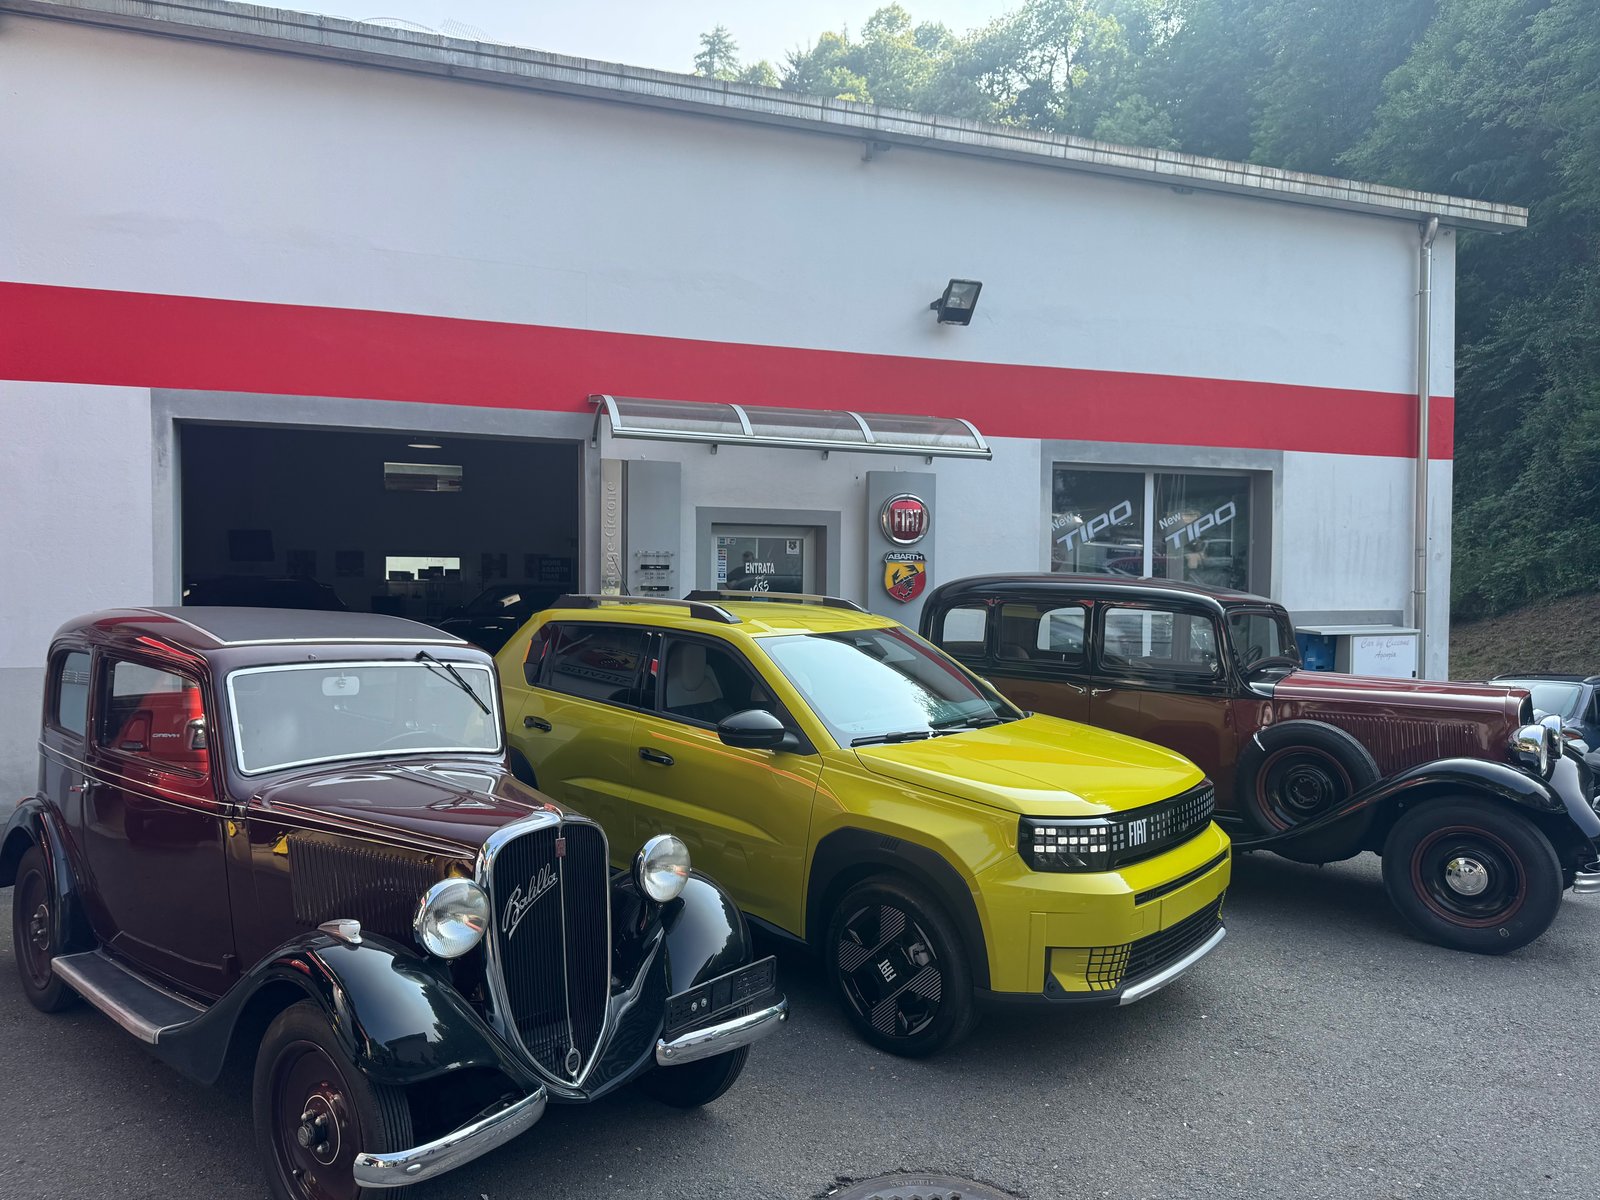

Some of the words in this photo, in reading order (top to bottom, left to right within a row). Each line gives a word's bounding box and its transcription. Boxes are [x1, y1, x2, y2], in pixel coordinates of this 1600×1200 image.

[604, 481, 616, 538] Ciccone
[894, 508, 922, 532] FIAT
[1051, 512, 1074, 531] New
[1158, 512, 1182, 530] New
[1056, 500, 1132, 552] TIPO
[1164, 501, 1237, 550] TIPO
[745, 562, 775, 574] ENTRATA
[888, 553, 923, 561] ABARTH
[1128, 818, 1148, 848] FIAT
[502, 863, 558, 938] Balilla
[877, 959, 897, 982] FIAT
